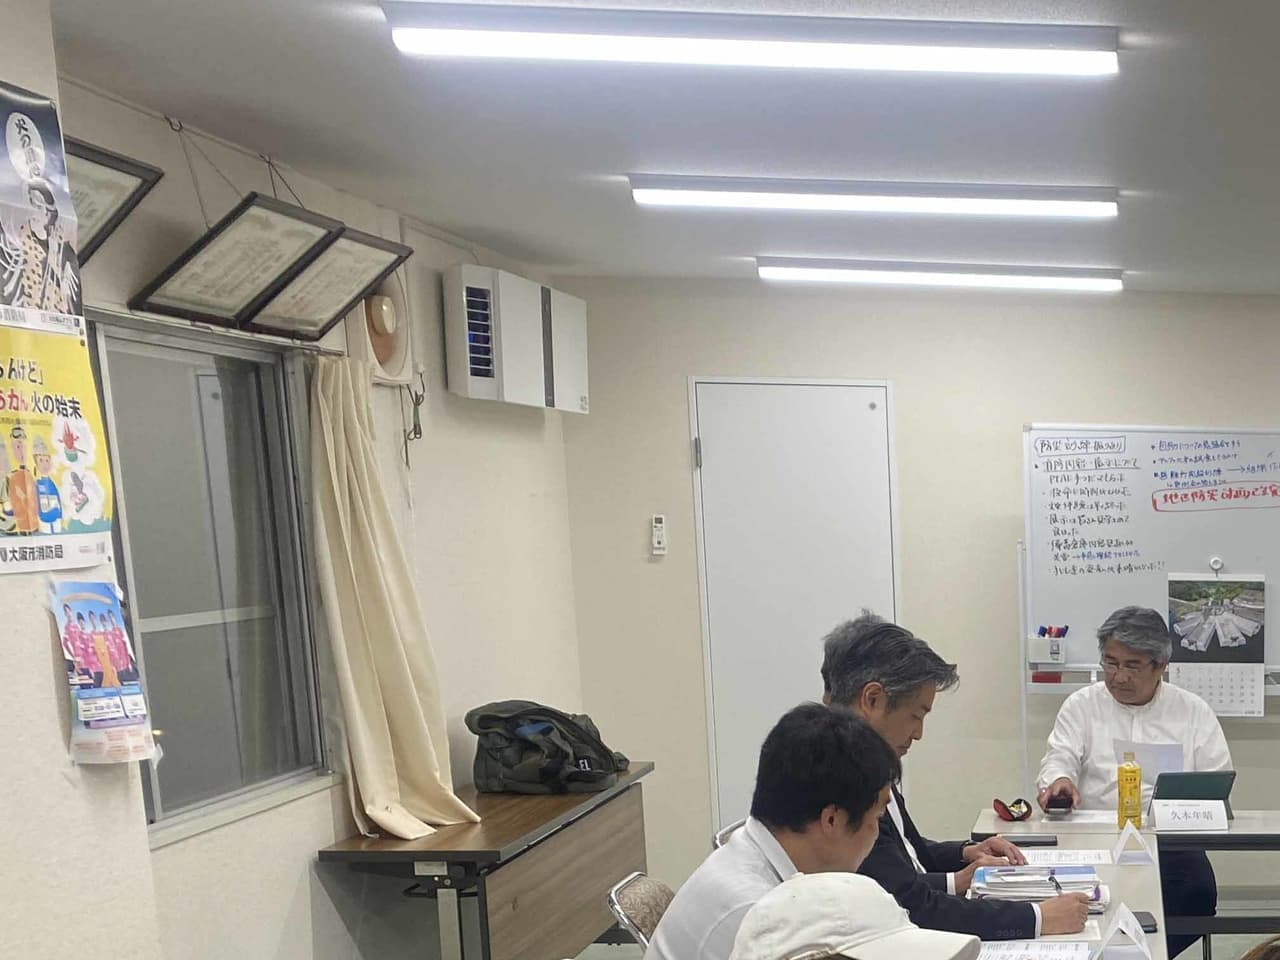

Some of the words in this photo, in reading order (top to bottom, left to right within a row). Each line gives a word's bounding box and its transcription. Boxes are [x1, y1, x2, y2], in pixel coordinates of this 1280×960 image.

[9, 544, 64, 562] 大阪市消防局
